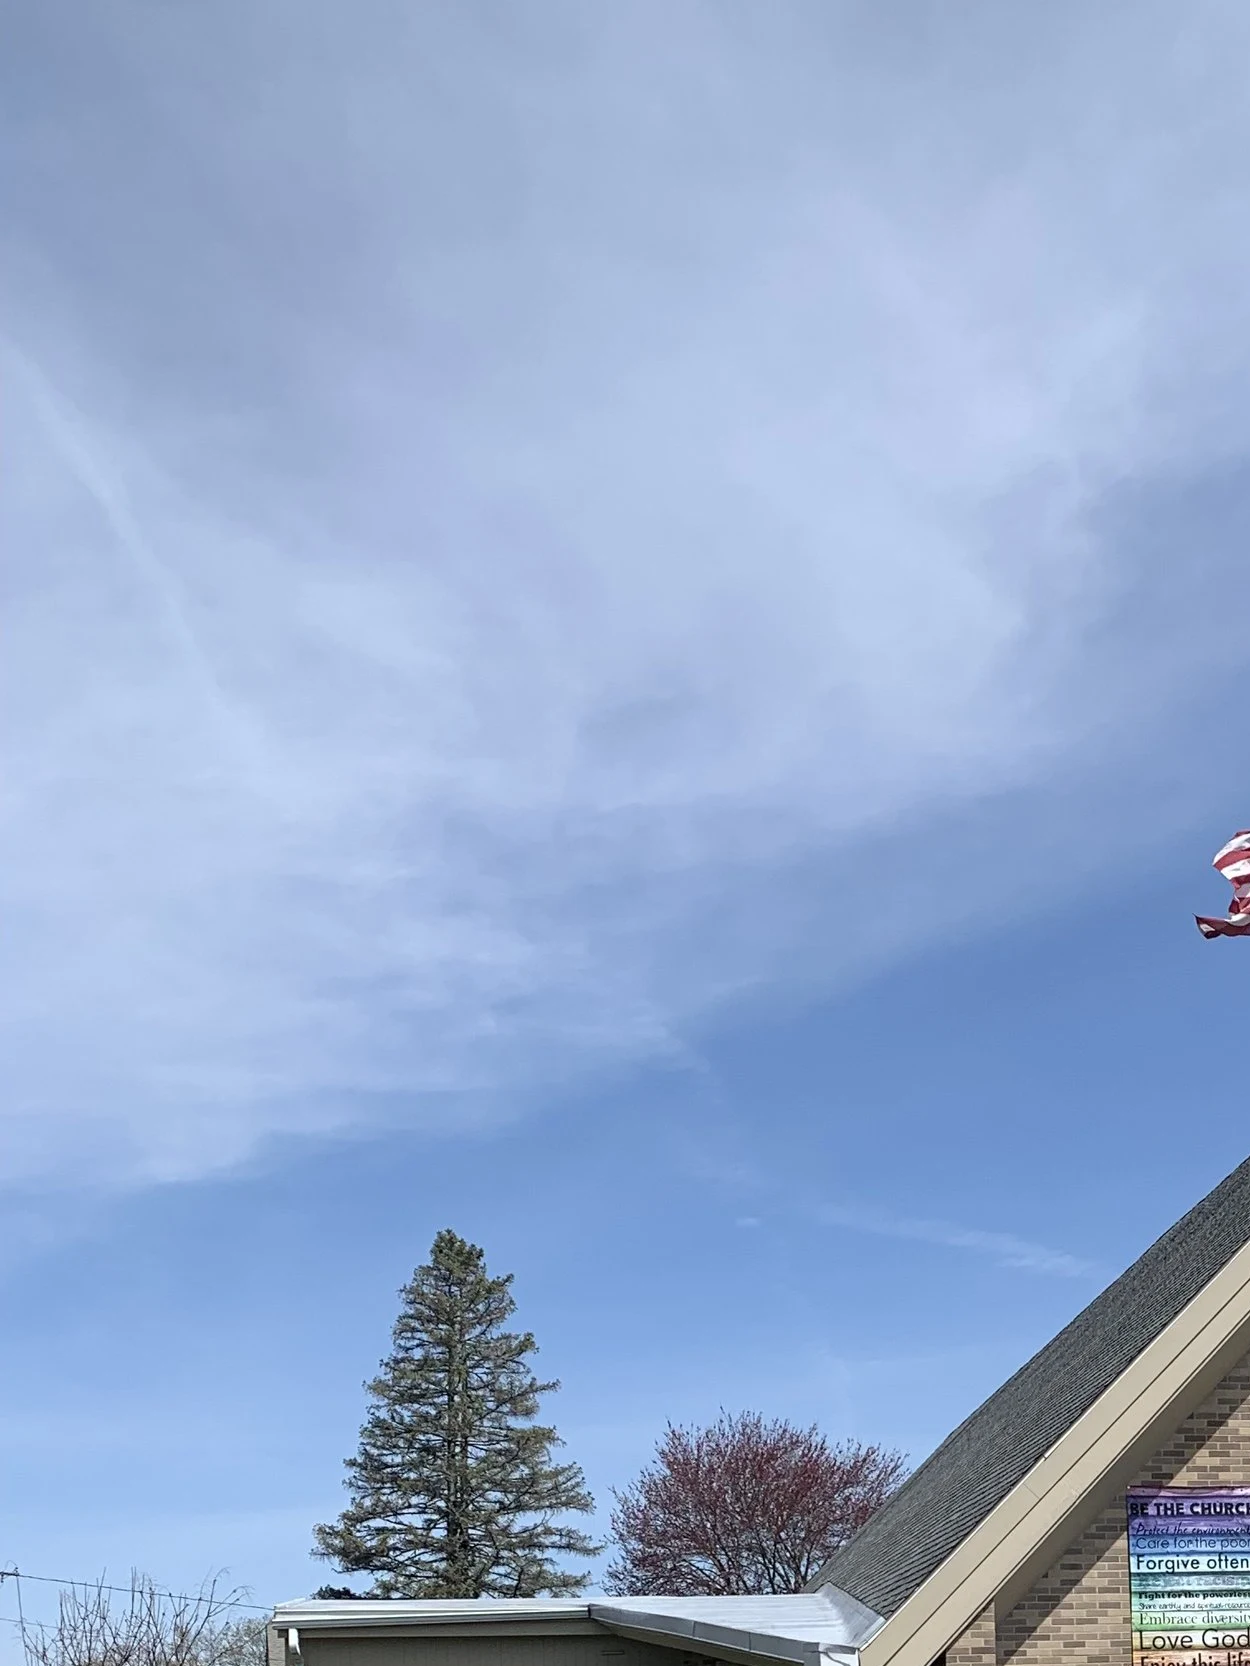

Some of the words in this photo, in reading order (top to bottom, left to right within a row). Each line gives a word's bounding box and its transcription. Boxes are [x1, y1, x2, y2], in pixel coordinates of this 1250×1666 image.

[1130, 1502, 1149, 1515] BE
[1154, 1502, 1185, 1516] THE
[1136, 1522, 1169, 1535] Protect
[1174, 1521, 1188, 1534] the
[1136, 1537, 1170, 1549] Care
[1174, 1537, 1192, 1548] for
[1194, 1537, 1217, 1548] the
[1136, 1554, 1200, 1574] Forgive
[1138, 1591, 1166, 1600] Fight
[1166, 1591, 1184, 1599] for
[1184, 1591, 1202, 1599] the
[1140, 1611, 1198, 1625] Embrace
[1140, 1630, 1193, 1650] Love
